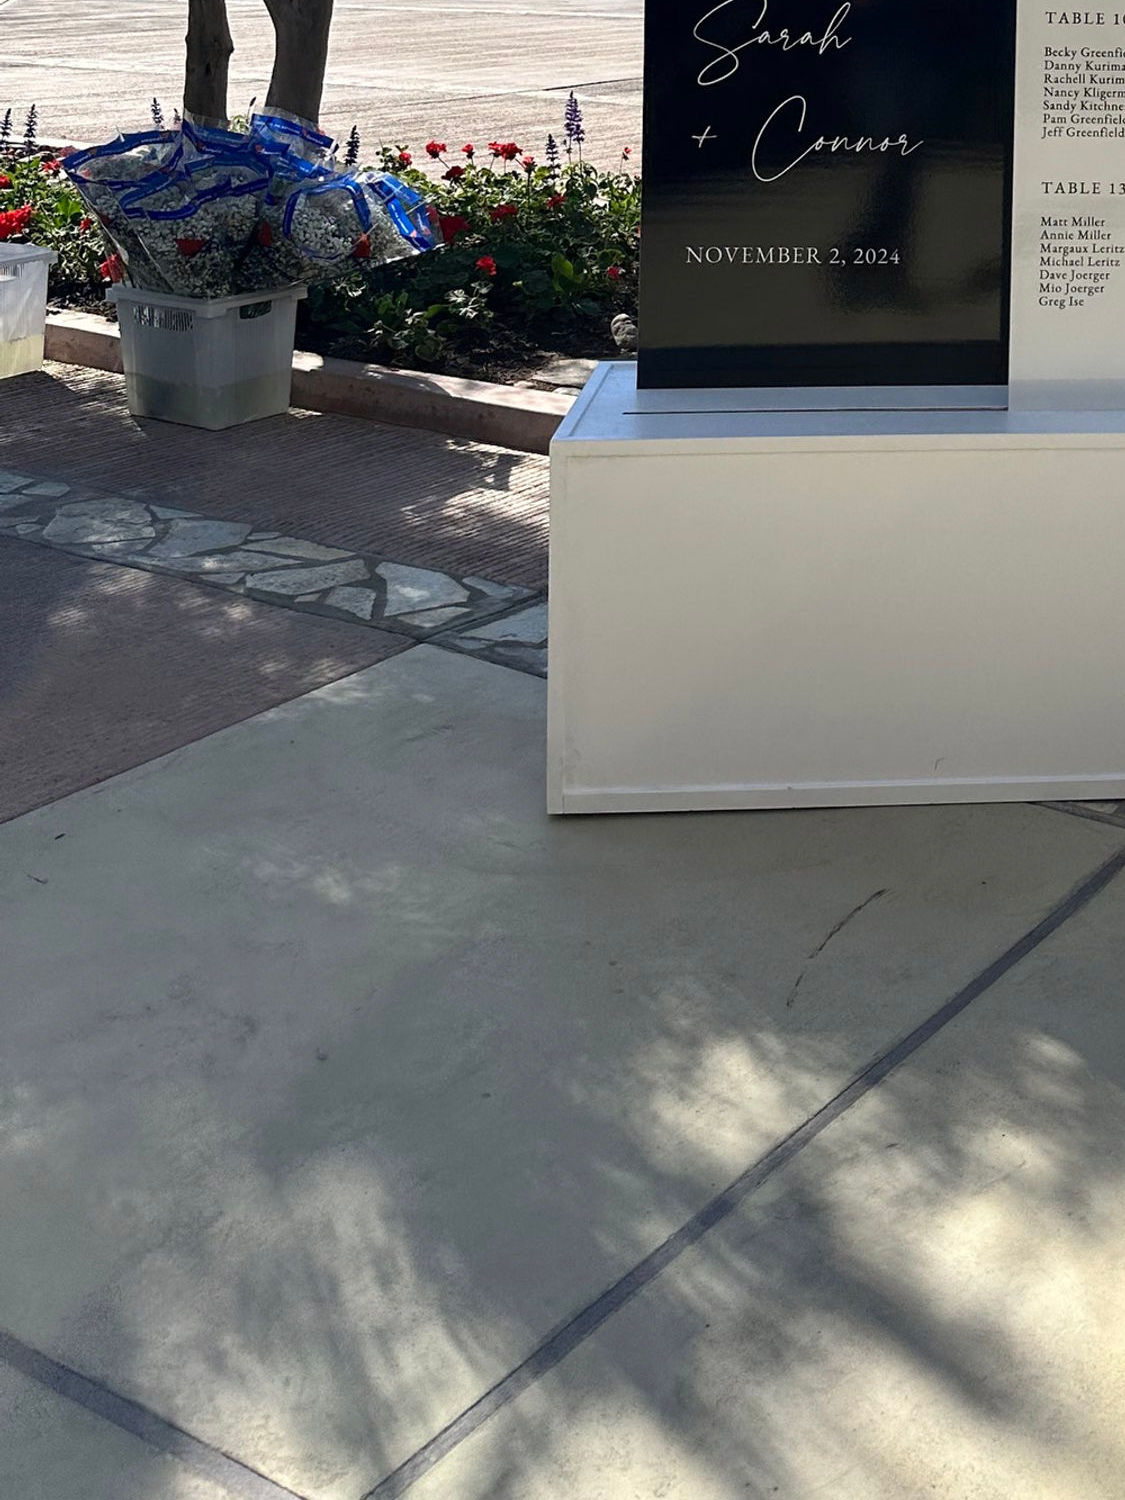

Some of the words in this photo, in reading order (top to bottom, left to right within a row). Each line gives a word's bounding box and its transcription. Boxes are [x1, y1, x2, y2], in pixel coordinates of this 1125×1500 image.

[1045, 12, 1105, 26] TABLE
[1044, 46, 1078, 61] Becky
[1044, 73, 1086, 84] Rachell
[752, 95, 924, 182] Connor
[1041, 126, 1065, 139] Jeff
[1066, 126, 1125, 138] Greenfield
[1042, 182, 1101, 195] TABLE
[1041, 216, 1068, 227] Matt
[1071, 216, 1106, 227] Miller
[686, 247, 822, 263] NOVEMBER
[830, 248, 845, 266] 2,
[854, 248, 899, 264] 2024
[1040, 243, 1089, 258] Margaux
[1092, 243, 1125, 254] Leritz
[1039, 296, 1066, 310] Greg
[1069, 296, 1084, 307] Ise
